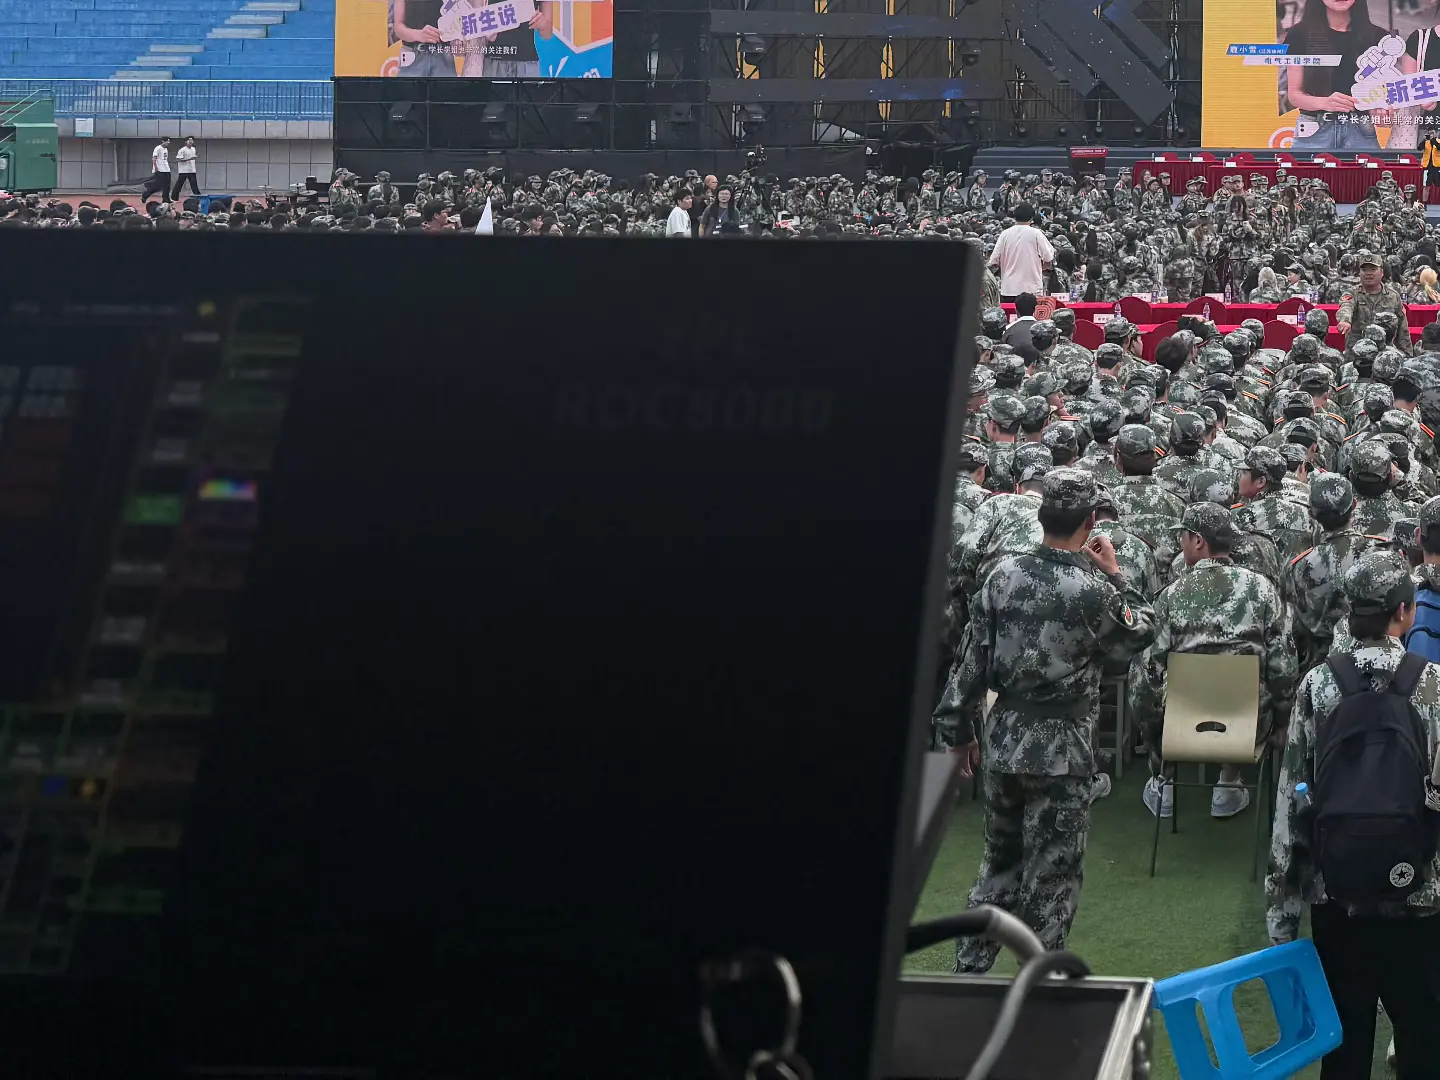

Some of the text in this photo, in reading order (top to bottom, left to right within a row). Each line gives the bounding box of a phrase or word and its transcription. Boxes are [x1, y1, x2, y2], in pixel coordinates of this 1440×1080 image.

[461, 3, 517, 36] 新生说
[1264, 57, 1321, 65] 电气工程学院
